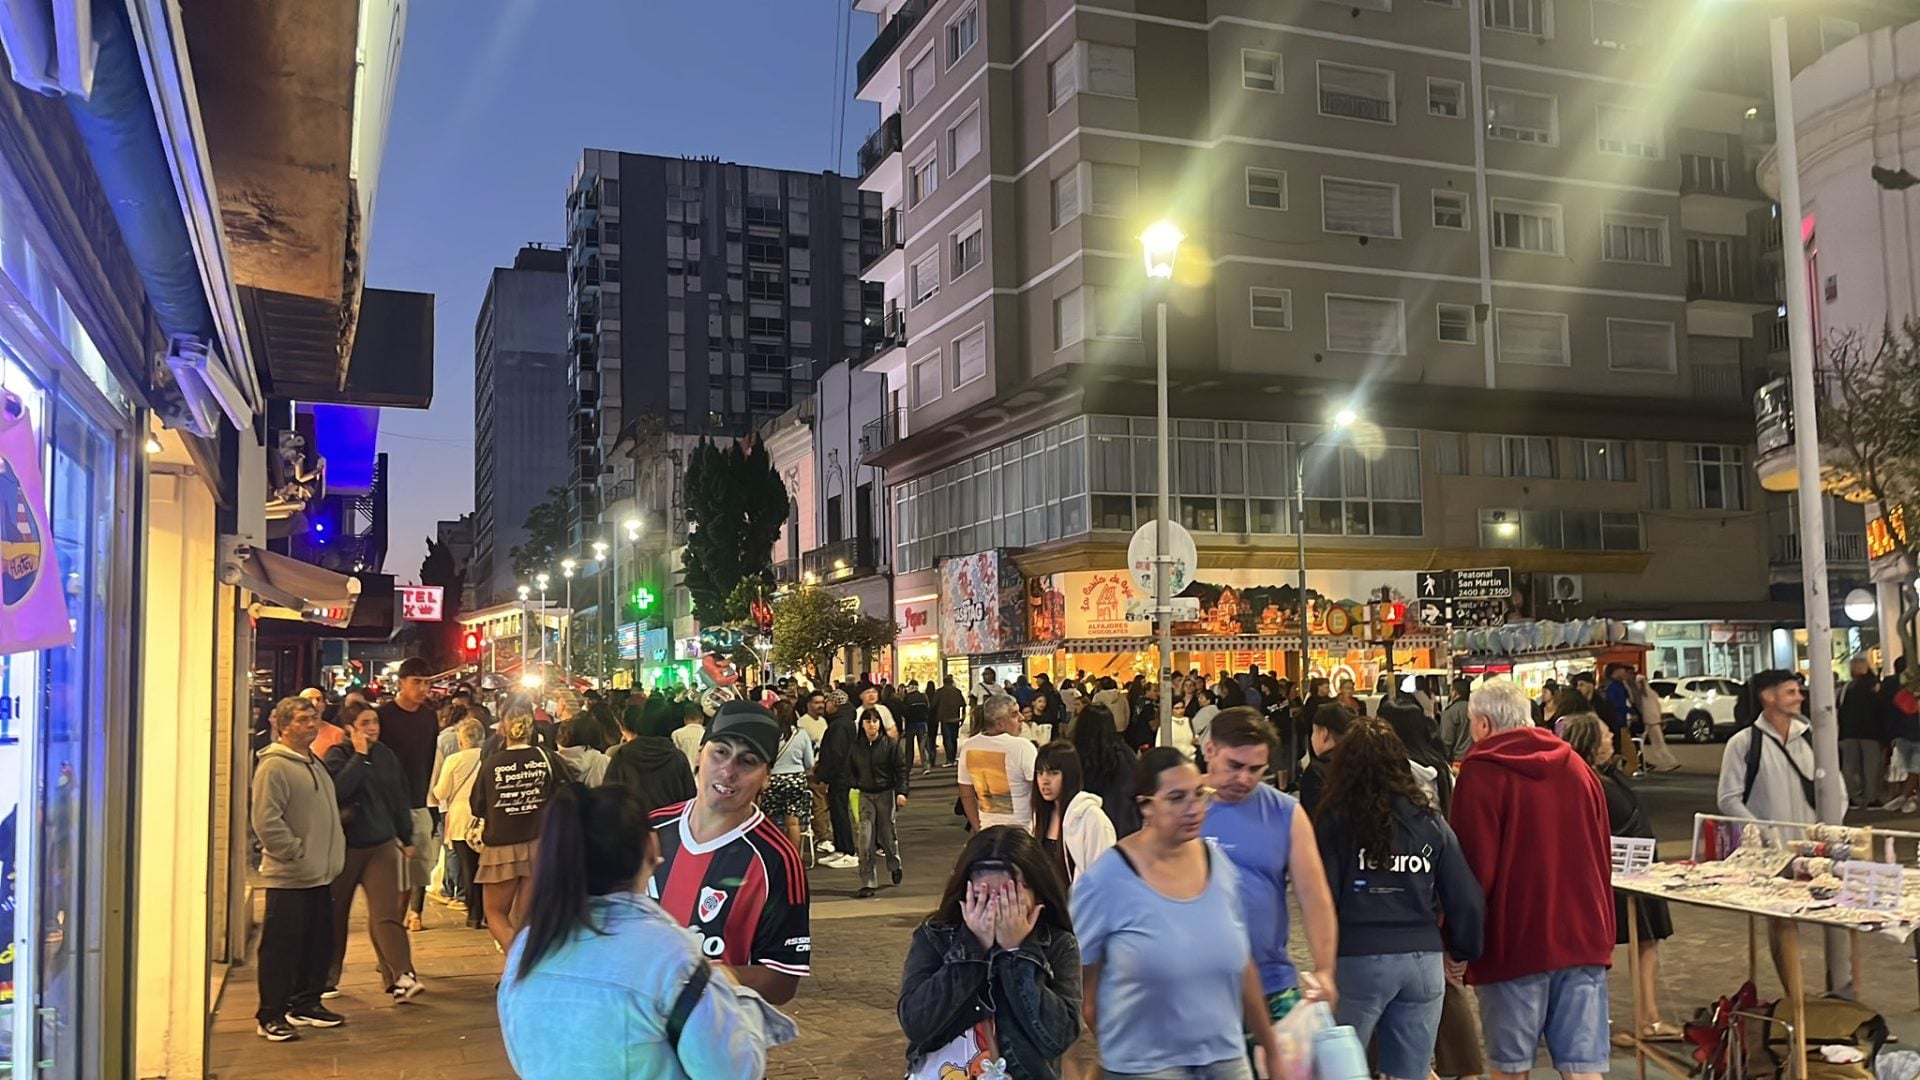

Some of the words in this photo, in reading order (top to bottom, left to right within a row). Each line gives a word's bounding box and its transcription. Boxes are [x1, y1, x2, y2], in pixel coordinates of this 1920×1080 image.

[1458, 570, 1493, 579] Peatonal
[1459, 580, 1473, 588] San
[1087, 623, 1129, 631] ALFAJORES
[494, 763, 517, 773] good
[505, 769, 546, 783] positivity
[520, 787, 541, 798] york
